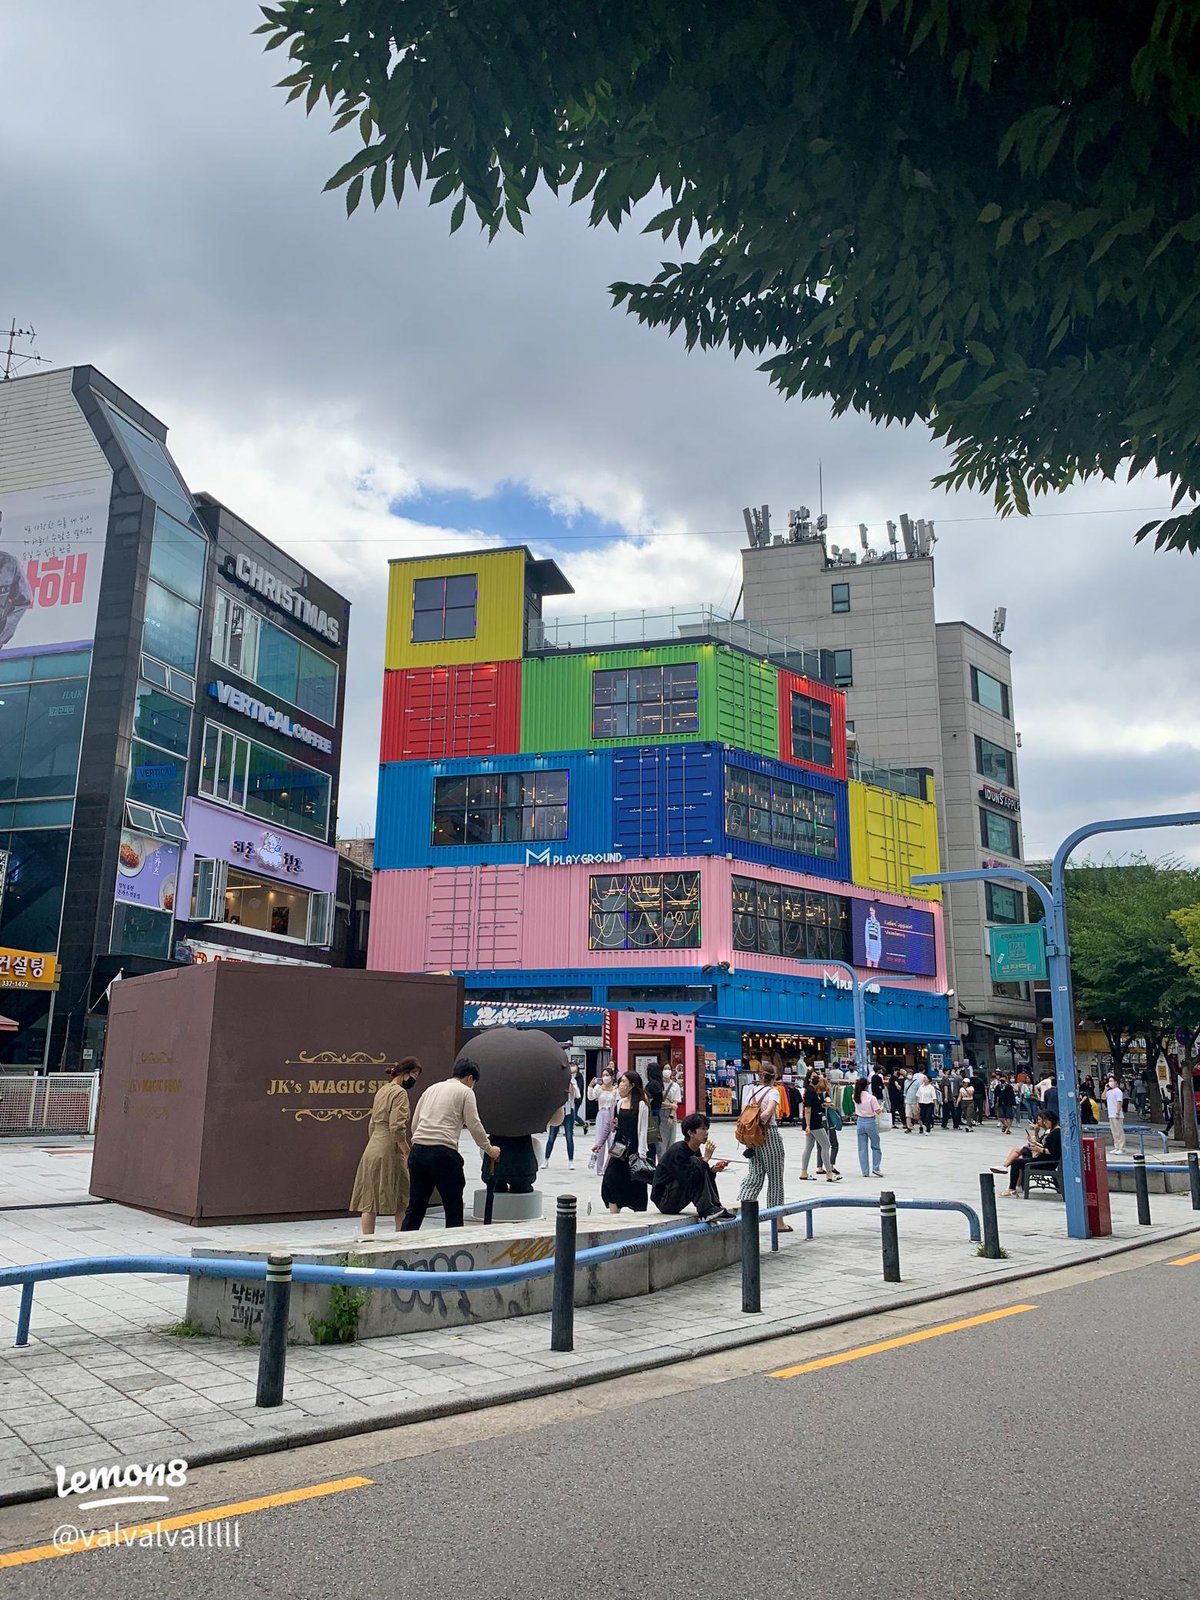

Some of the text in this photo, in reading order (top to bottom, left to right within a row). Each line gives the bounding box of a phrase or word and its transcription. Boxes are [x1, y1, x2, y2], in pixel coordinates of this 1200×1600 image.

[235, 553, 339, 644] CHRISTMAS
[216, 680, 333, 755] VERTICAL COFFEE
[553, 852, 622, 866] PLAYGROUND
[635, 1017, 682, 1031] 파쿠모리
[267, 1079, 303, 1096] JK's
[308, 1079, 366, 1094] MAGIC
